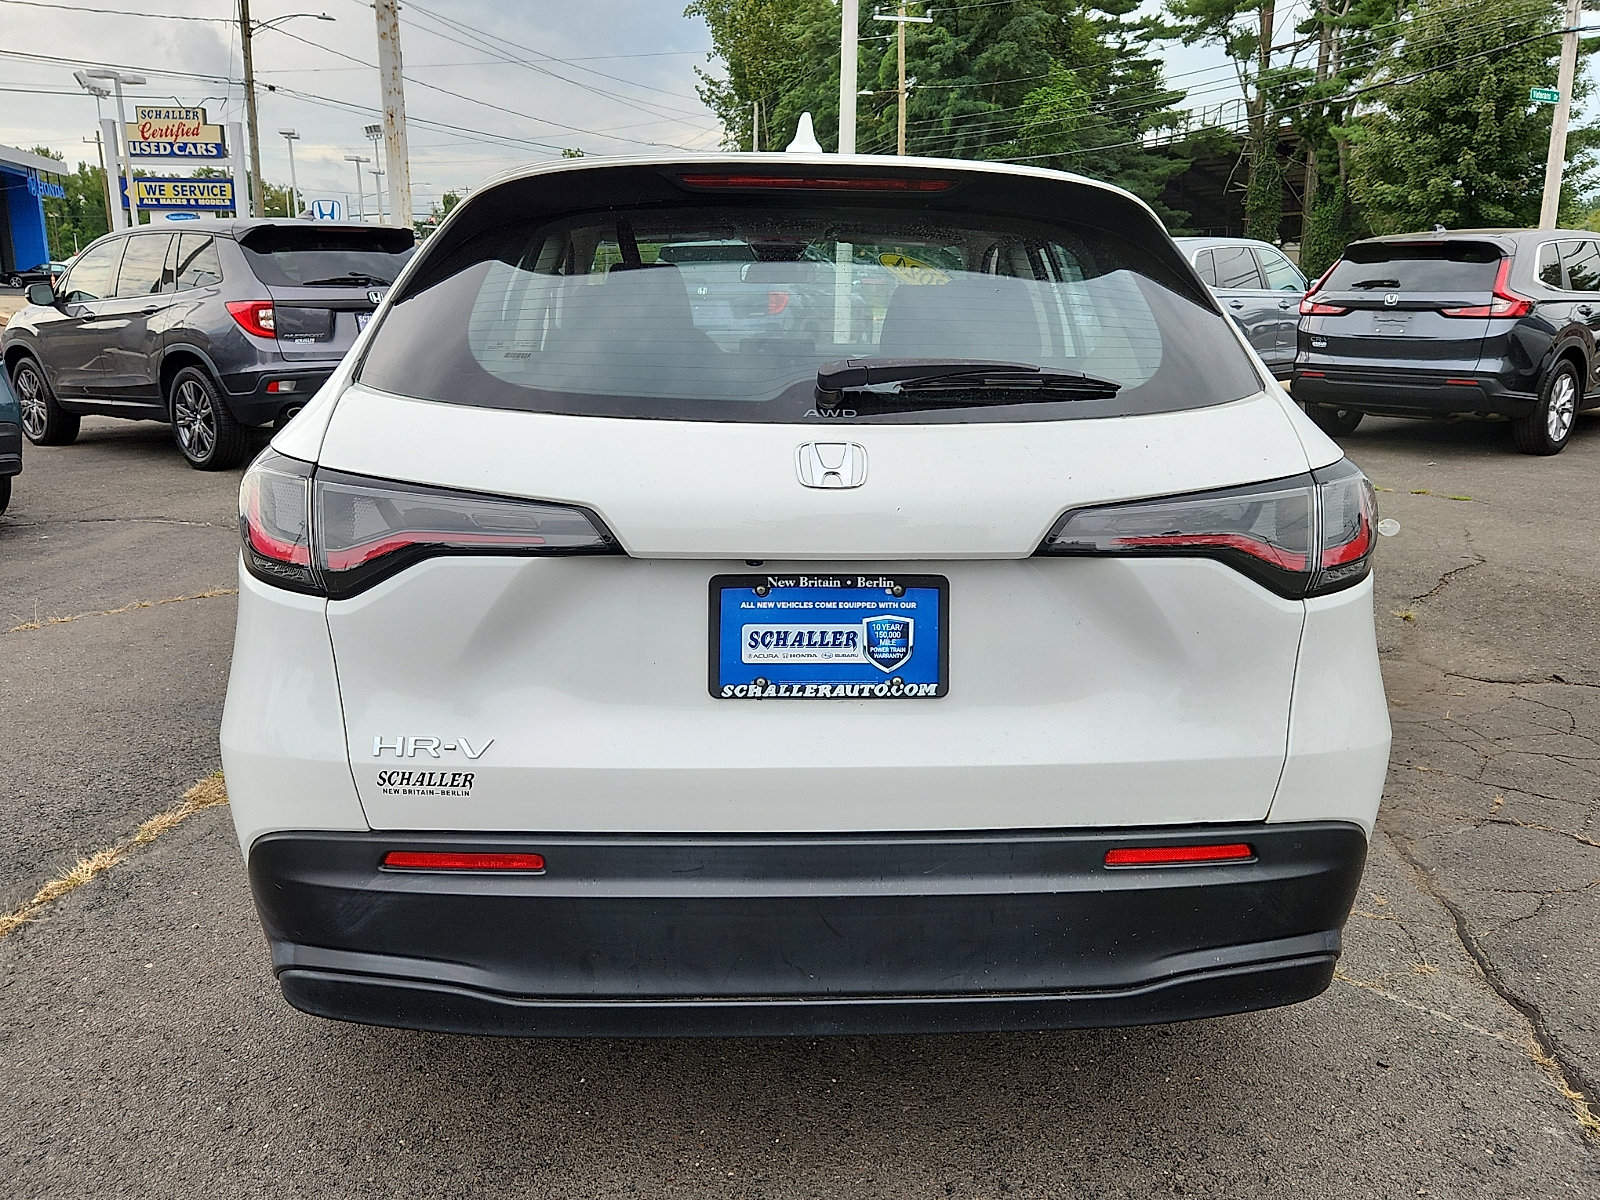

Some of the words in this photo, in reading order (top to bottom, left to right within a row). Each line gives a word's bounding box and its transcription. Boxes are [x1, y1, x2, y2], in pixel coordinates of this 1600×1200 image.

[140, 109, 200, 121] SCHALLER
[138, 121, 201, 143] Certified
[128, 141, 171, 155] USED
[173, 142, 218, 156] CARS
[38, 181, 66, 199] HONDA
[144, 184, 166, 196] WE
[172, 184, 227, 197] SERVICE
[198, 198, 231, 206] MODELS
[803, 409, 858, 418] AWD
[767, 576, 796, 588] New
[799, 576, 841, 588] Britain
[856, 576, 895, 588] Berlin
[740, 601, 755, 609] ALL
[757, 601, 775, 609] NEW
[776, 601, 814, 609] VEHICLES
[814, 601, 837, 609] COME
[838, 601, 877, 609] EQUIPPED
[878, 601, 898, 609] WITH
[900, 601, 917, 609] OUR
[872, 623, 881, 631] 10
[881, 623, 904, 631] YEAR/
[748, 630, 859, 652] SCHALLER
[875, 631, 902, 639] 150,000
[720, 683, 939, 698] SCHALLERAUTO.COM
[372, 735, 495, 760] HR-V
[376, 770, 475, 790] SCHALLER
